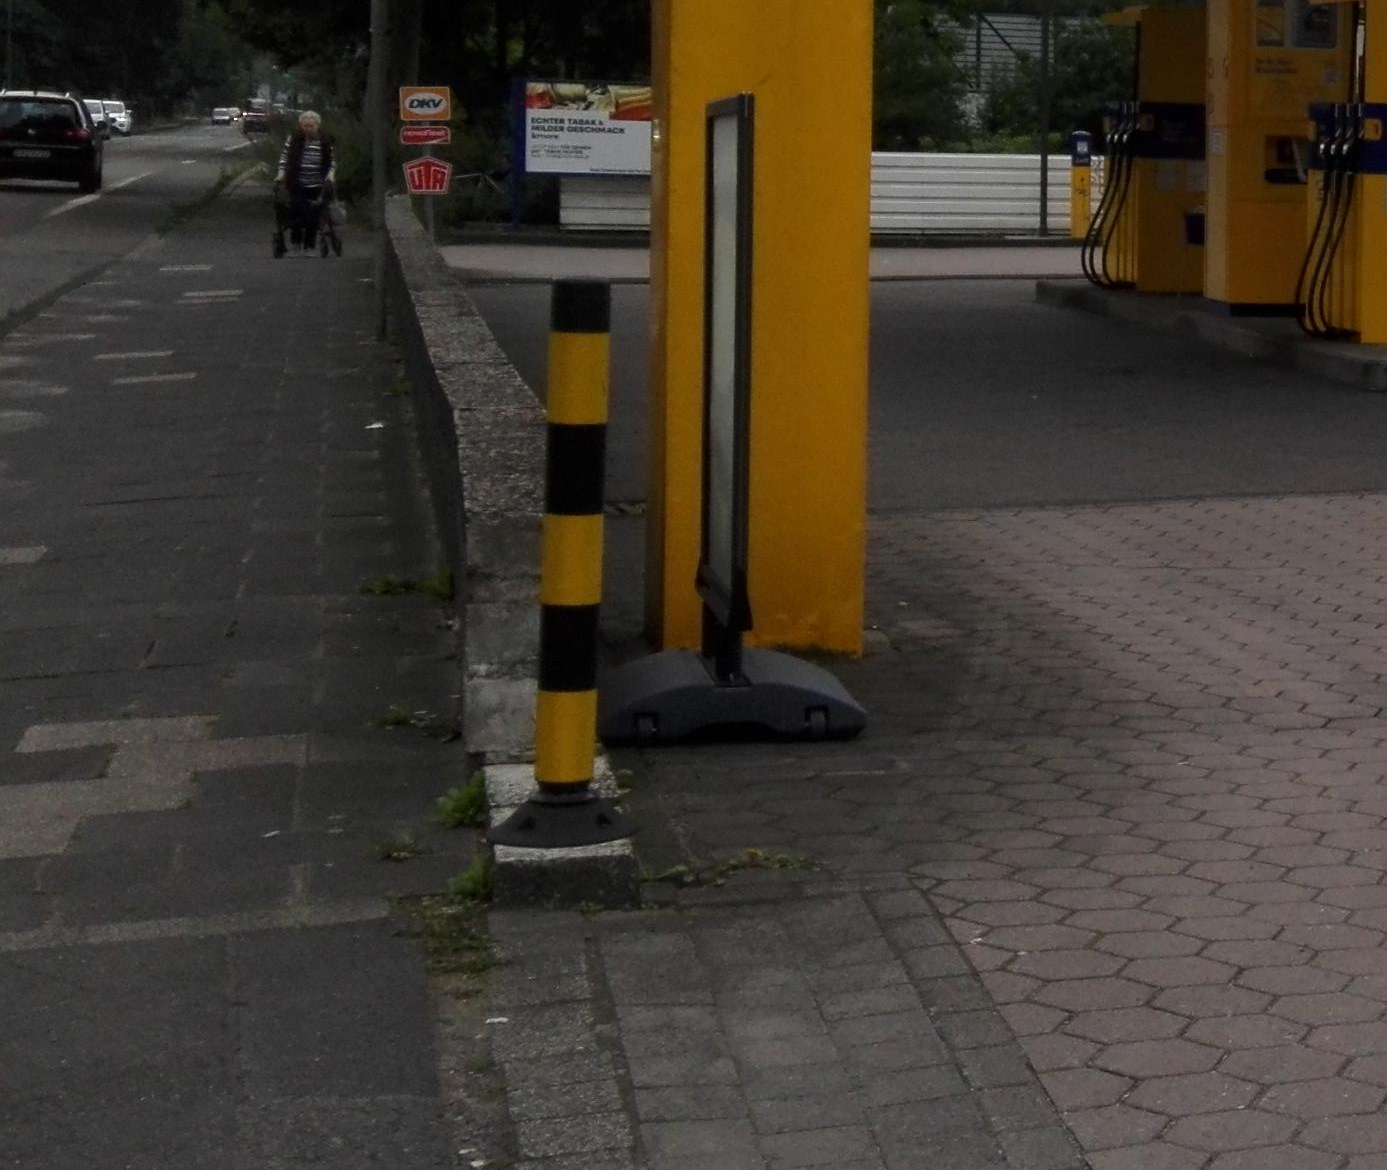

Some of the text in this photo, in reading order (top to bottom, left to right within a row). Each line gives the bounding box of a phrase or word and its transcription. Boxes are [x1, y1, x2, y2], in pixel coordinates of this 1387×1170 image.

[408, 98, 443, 109] DKV
[566, 126, 625, 134] GESCHMACK
[407, 162, 448, 191] UTA
